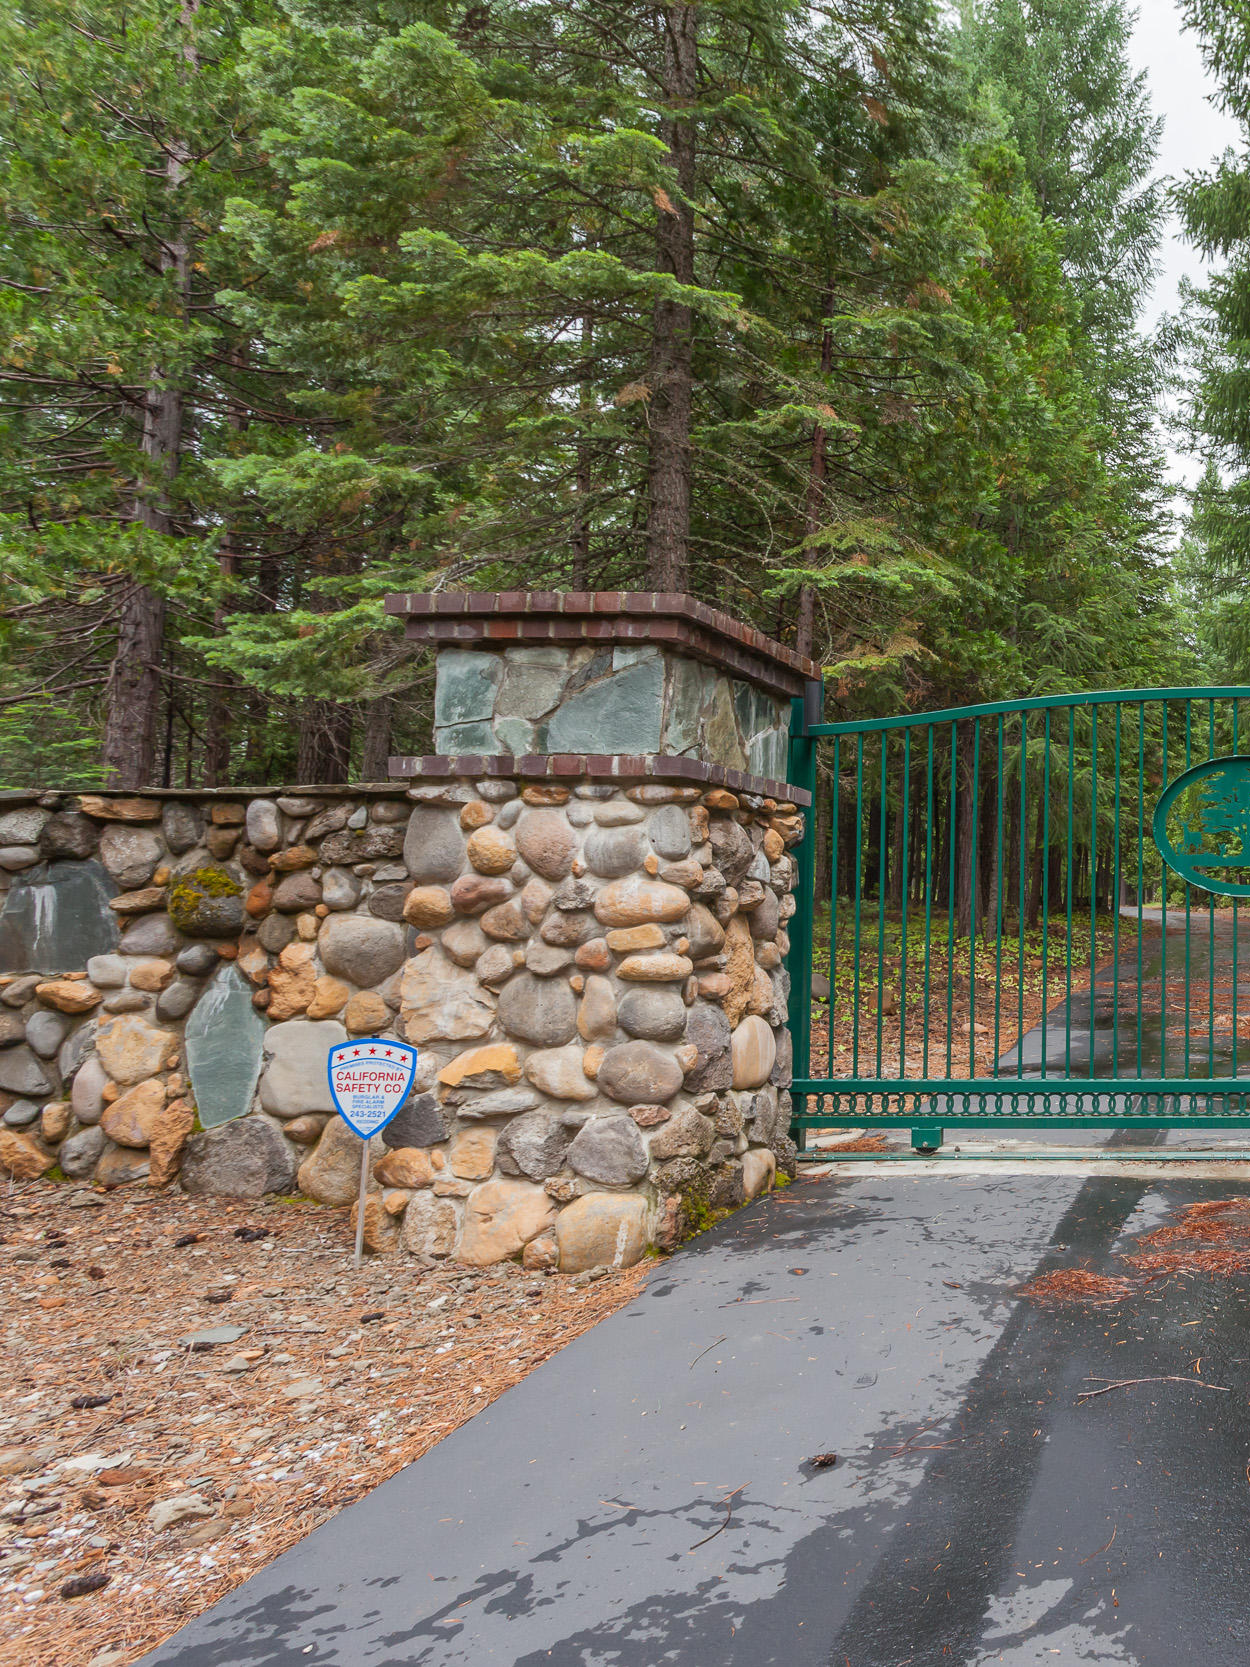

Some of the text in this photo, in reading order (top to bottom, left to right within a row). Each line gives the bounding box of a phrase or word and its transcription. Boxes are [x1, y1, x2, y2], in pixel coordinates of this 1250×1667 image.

[336, 1071, 405, 1081] CALIFORNIA
[336, 1083, 404, 1093] SAFETY CO.
[350, 1110, 386, 1118] 243-2521
